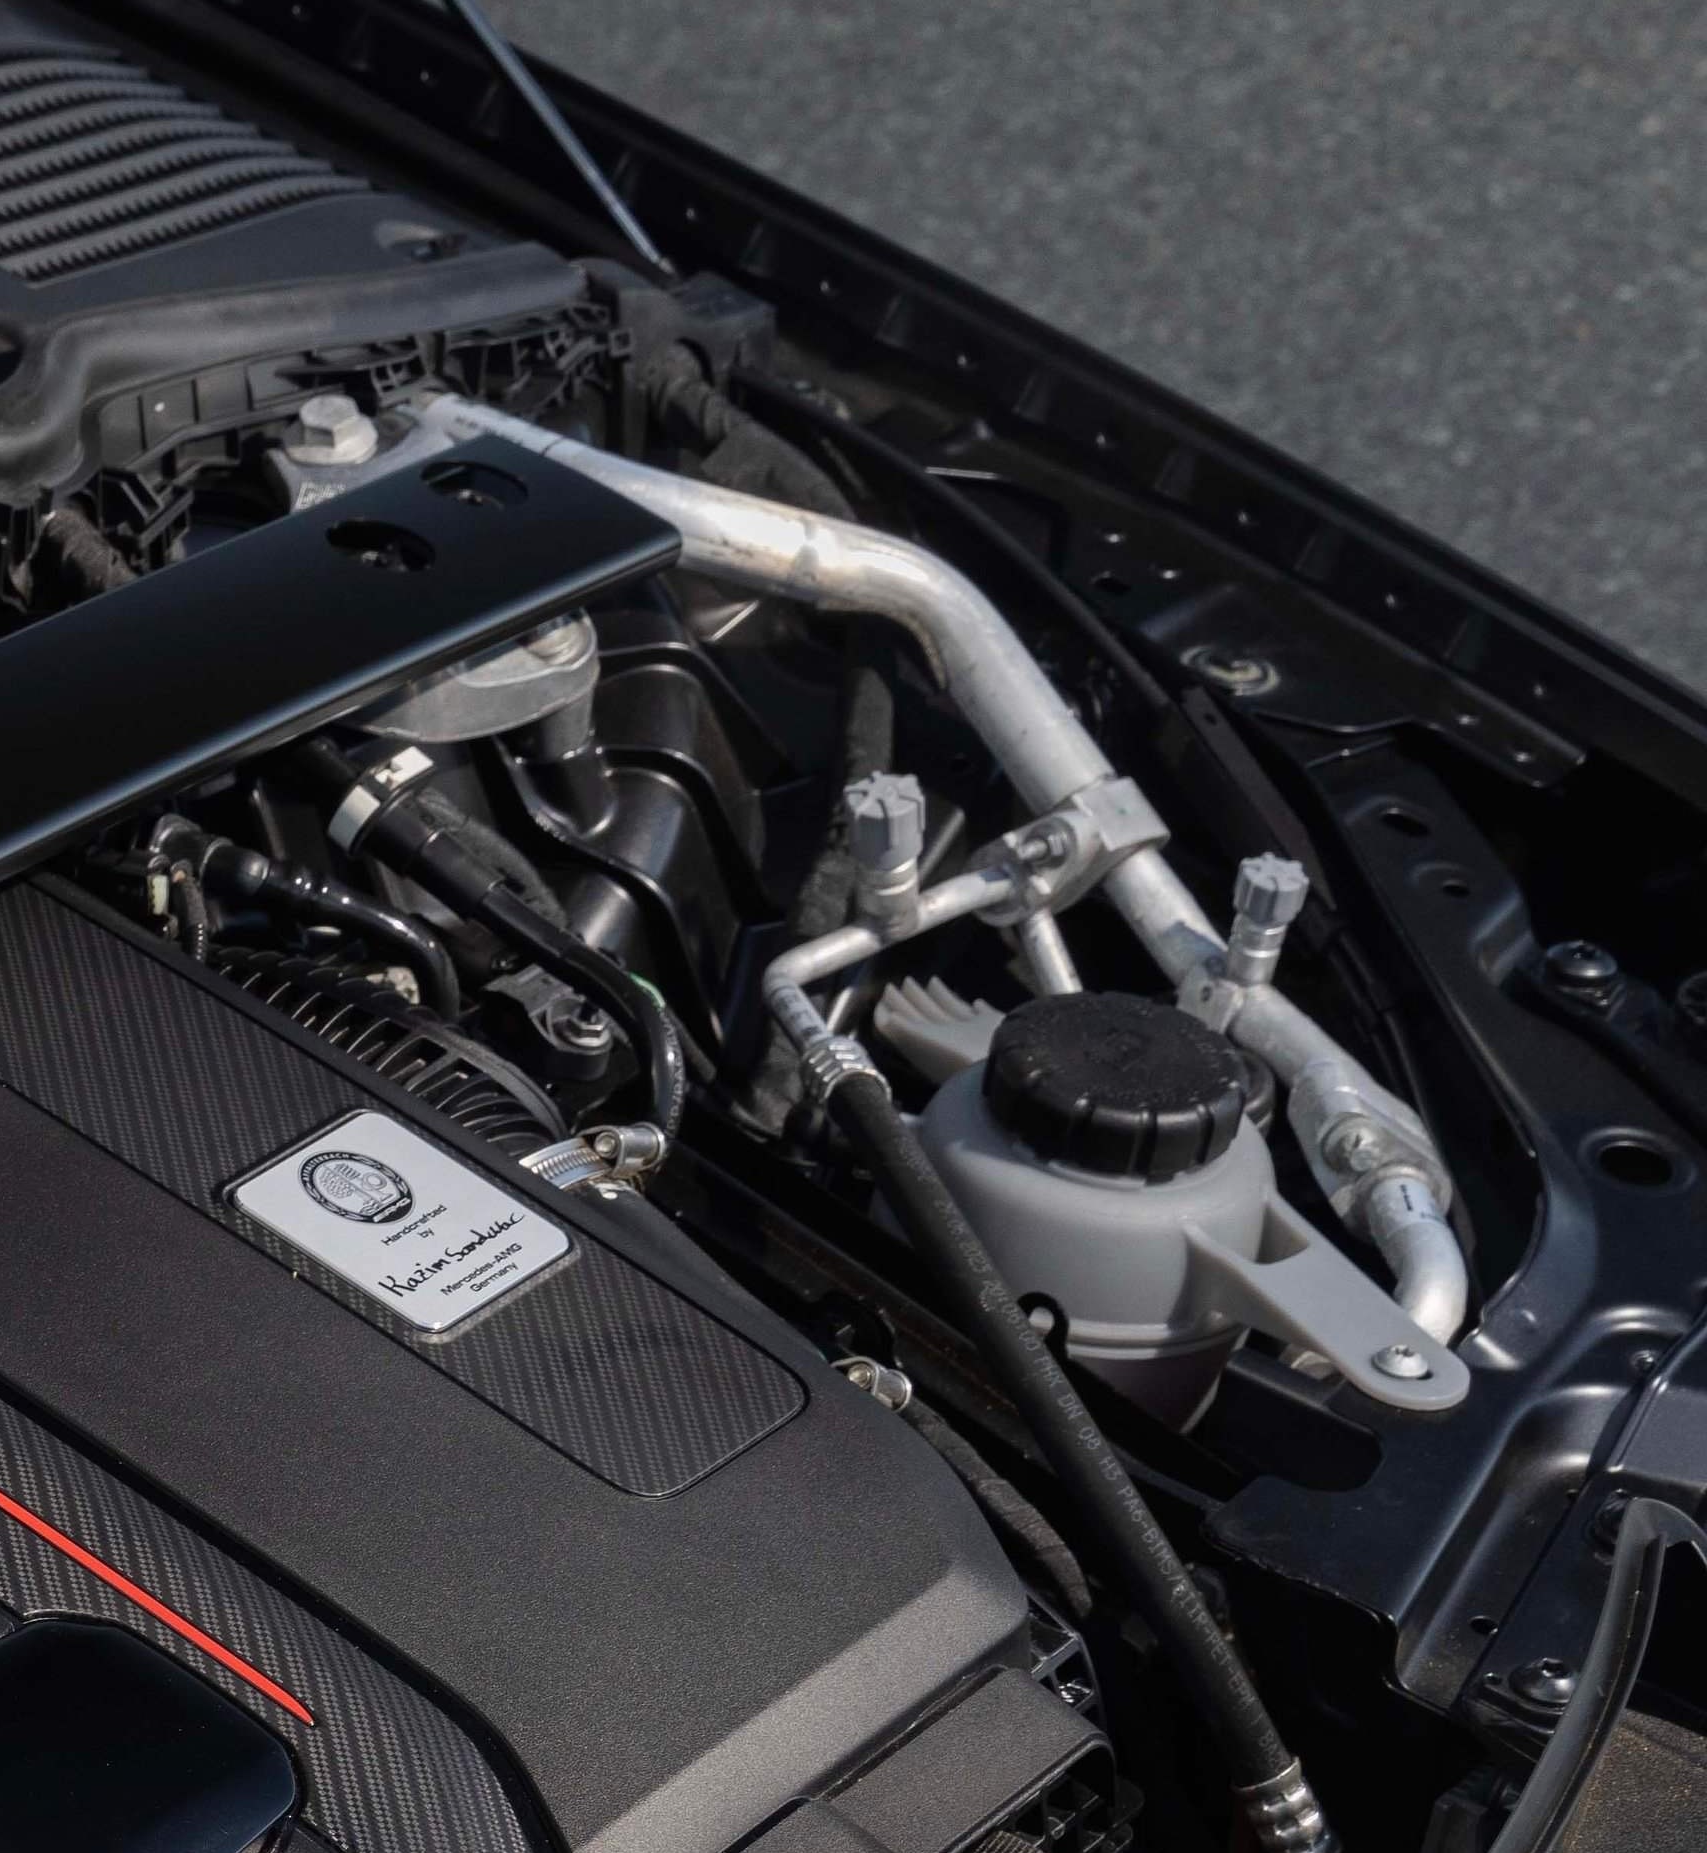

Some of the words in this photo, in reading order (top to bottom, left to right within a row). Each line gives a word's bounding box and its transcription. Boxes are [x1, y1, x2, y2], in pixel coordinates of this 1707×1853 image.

[380, 1204, 447, 1246] Handcrafted
[419, 1226, 434, 1239] by
[440, 1241, 523, 1297] Mercedes-AMG
[470, 1261, 519, 1293] Germany
